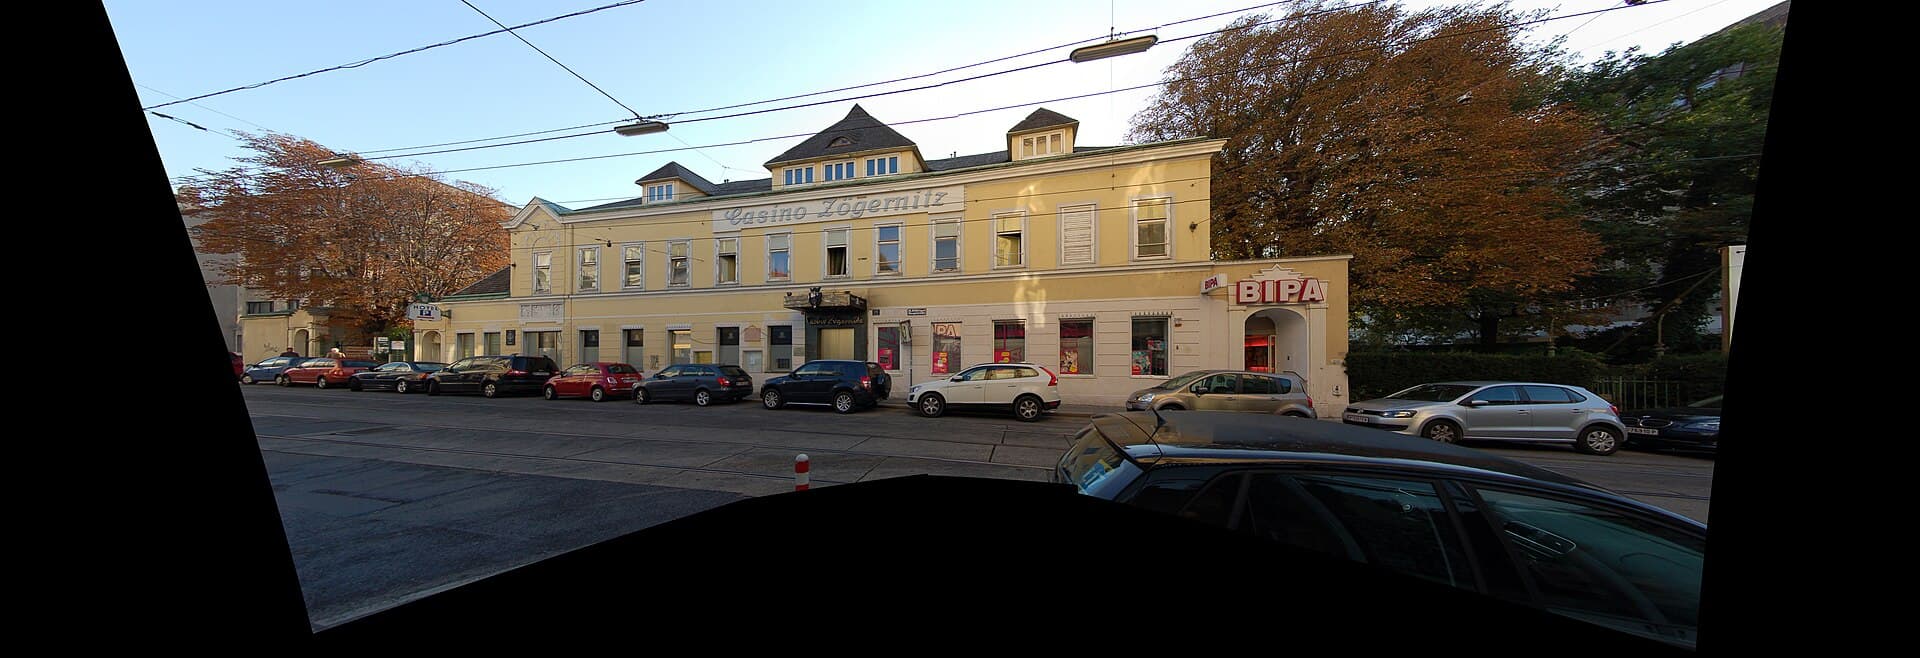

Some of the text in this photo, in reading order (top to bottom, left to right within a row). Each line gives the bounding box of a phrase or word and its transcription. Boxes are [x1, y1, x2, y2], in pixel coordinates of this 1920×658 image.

[725, 190, 949, 225] Casino Zögernitz
[1204, 277, 1218, 290] BIPA
[1236, 278, 1324, 304] BIPA
